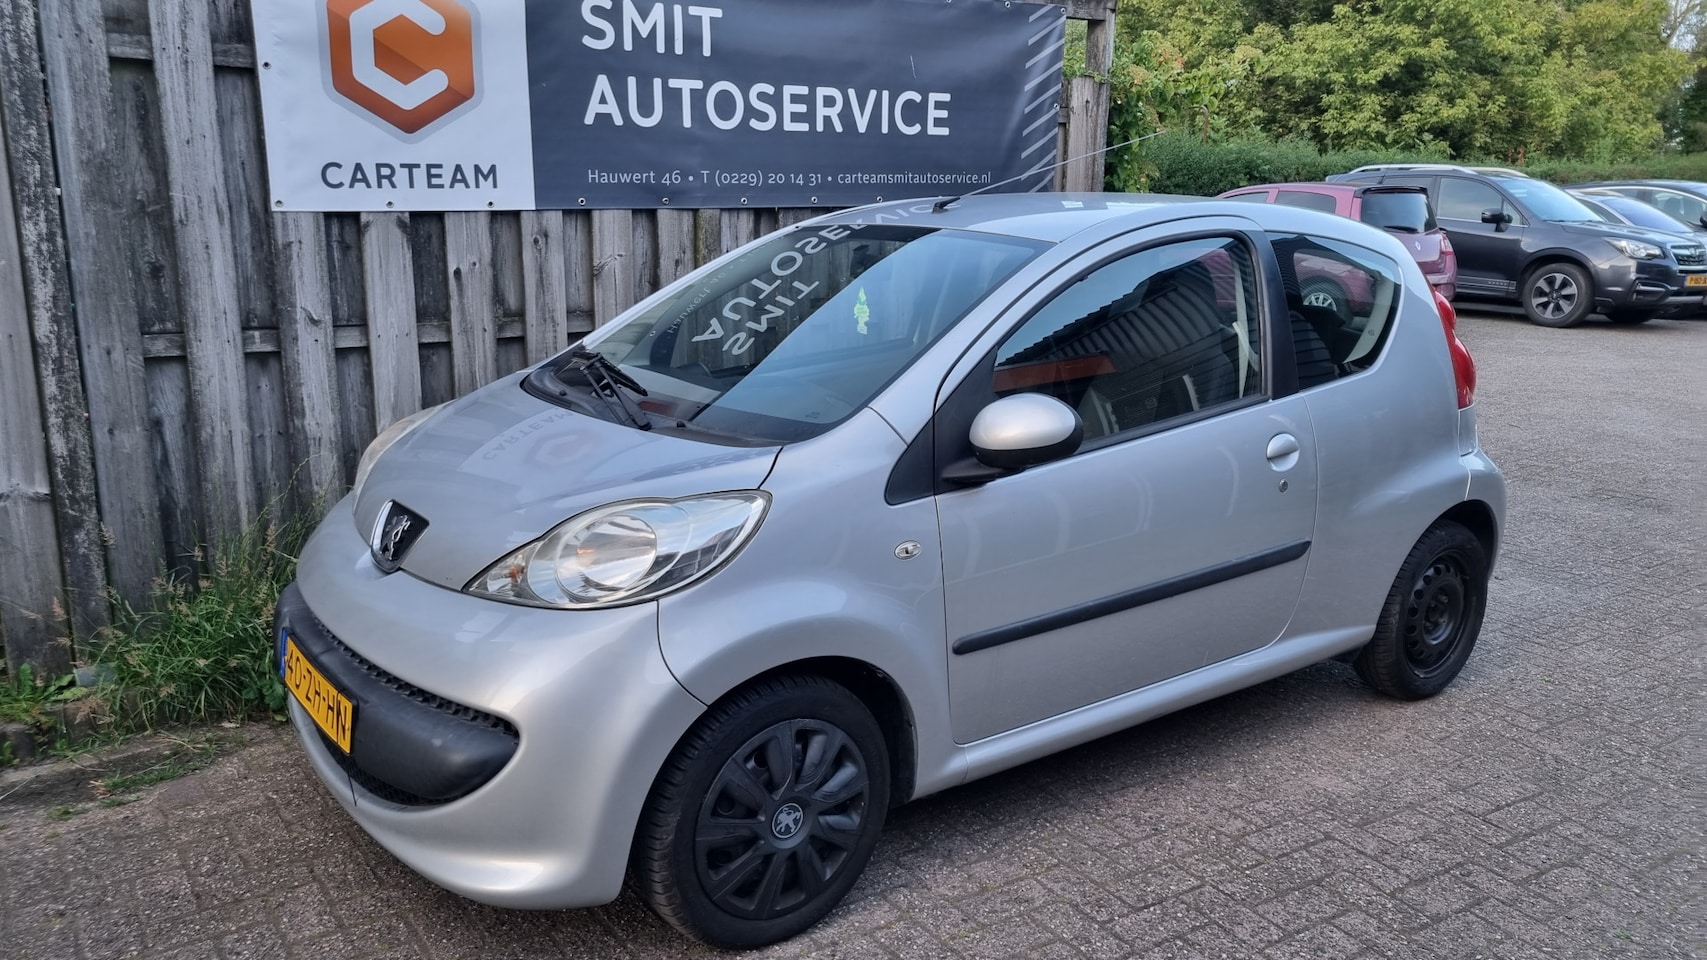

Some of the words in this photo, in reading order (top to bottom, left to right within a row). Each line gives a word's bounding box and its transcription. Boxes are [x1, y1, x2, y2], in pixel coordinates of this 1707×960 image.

[581, 0, 723, 57] SMIT
[584, 74, 952, 136] AUTOSERVICE
[321, 162, 498, 189] CARTEAM
[588, 169, 656, 184] Hauwert
[661, 170, 681, 187] 46
[701, 170, 710, 184] T
[715, 170, 763, 187] (0229)
[768, 173, 785, 184] 20
[790, 173, 804, 186] 14
[808, 173, 822, 186] 31
[838, 170, 991, 184] carteamsmitautoservice.nl
[286, 649, 348, 742] 40-ZH-HN
